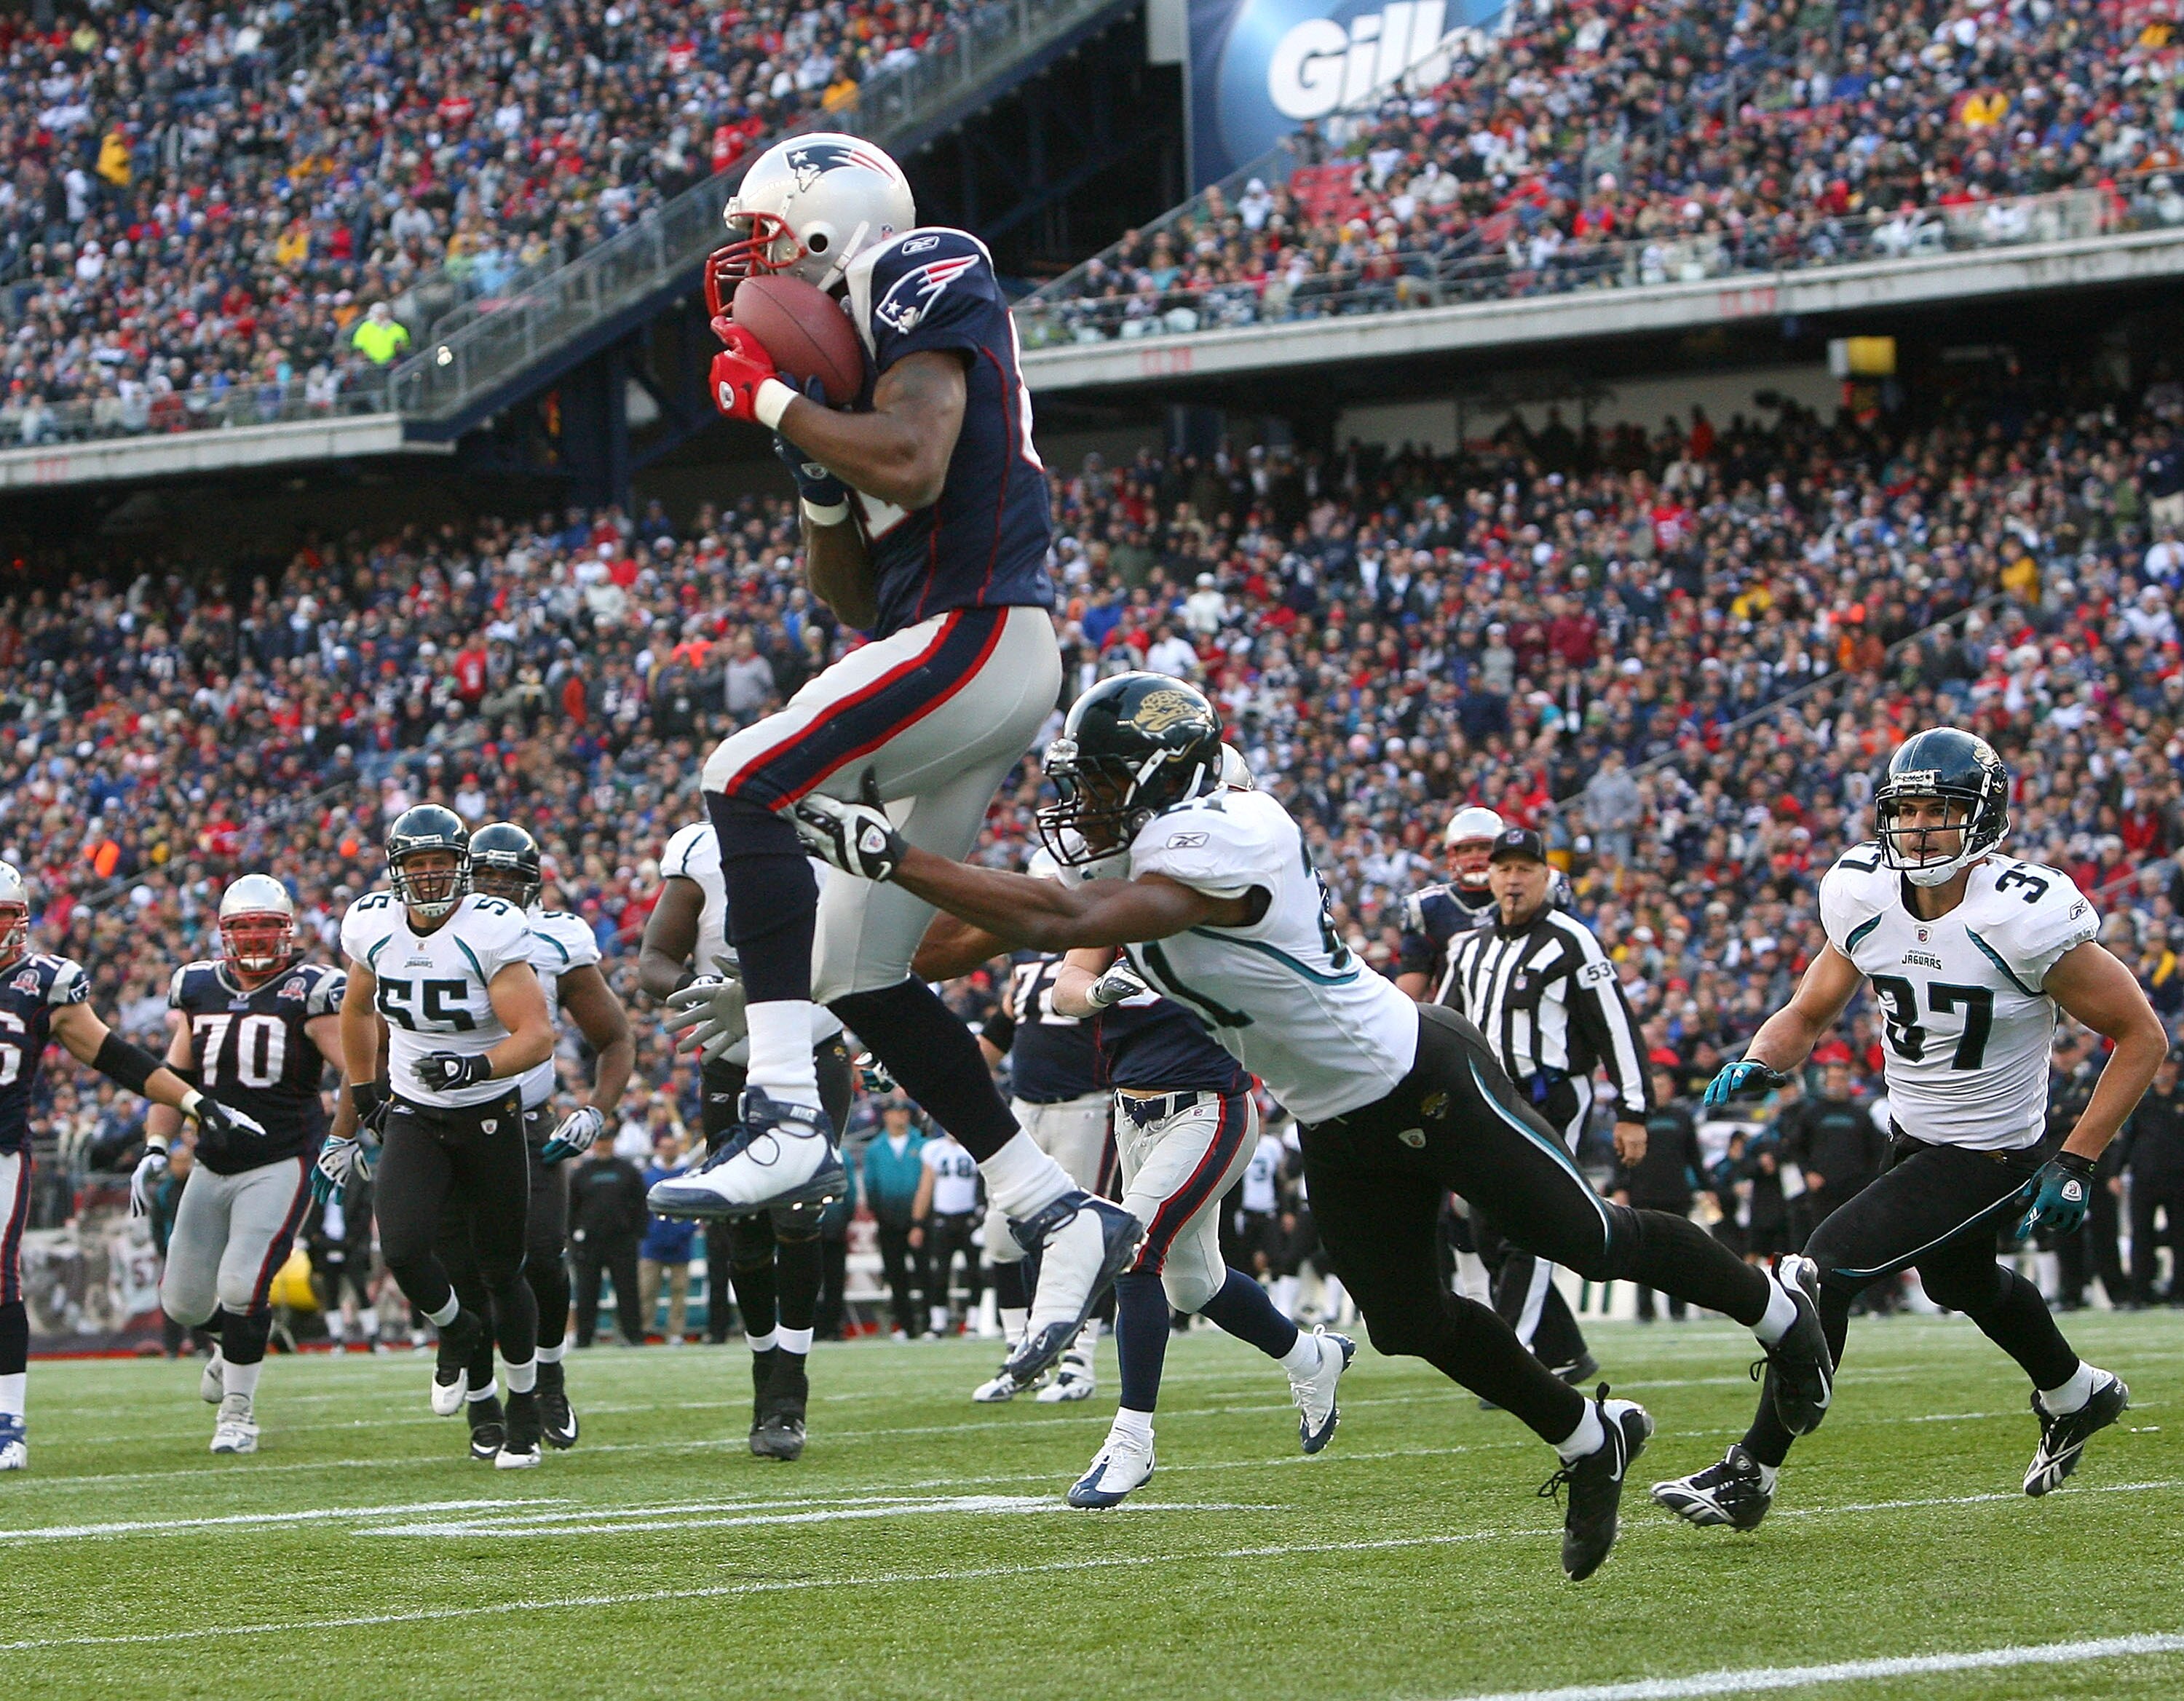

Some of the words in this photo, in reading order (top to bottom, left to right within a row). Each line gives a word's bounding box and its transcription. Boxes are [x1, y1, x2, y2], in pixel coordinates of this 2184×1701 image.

[1268, 0, 1485, 122] Gill
[1587, 961, 1610, 981] 53
[1902, 954, 1942, 970] JAGUARS
[376, 977, 476, 1031] 55
[1867, 973, 1994, 1071] 37
[192, 1013, 287, 1089] 70
